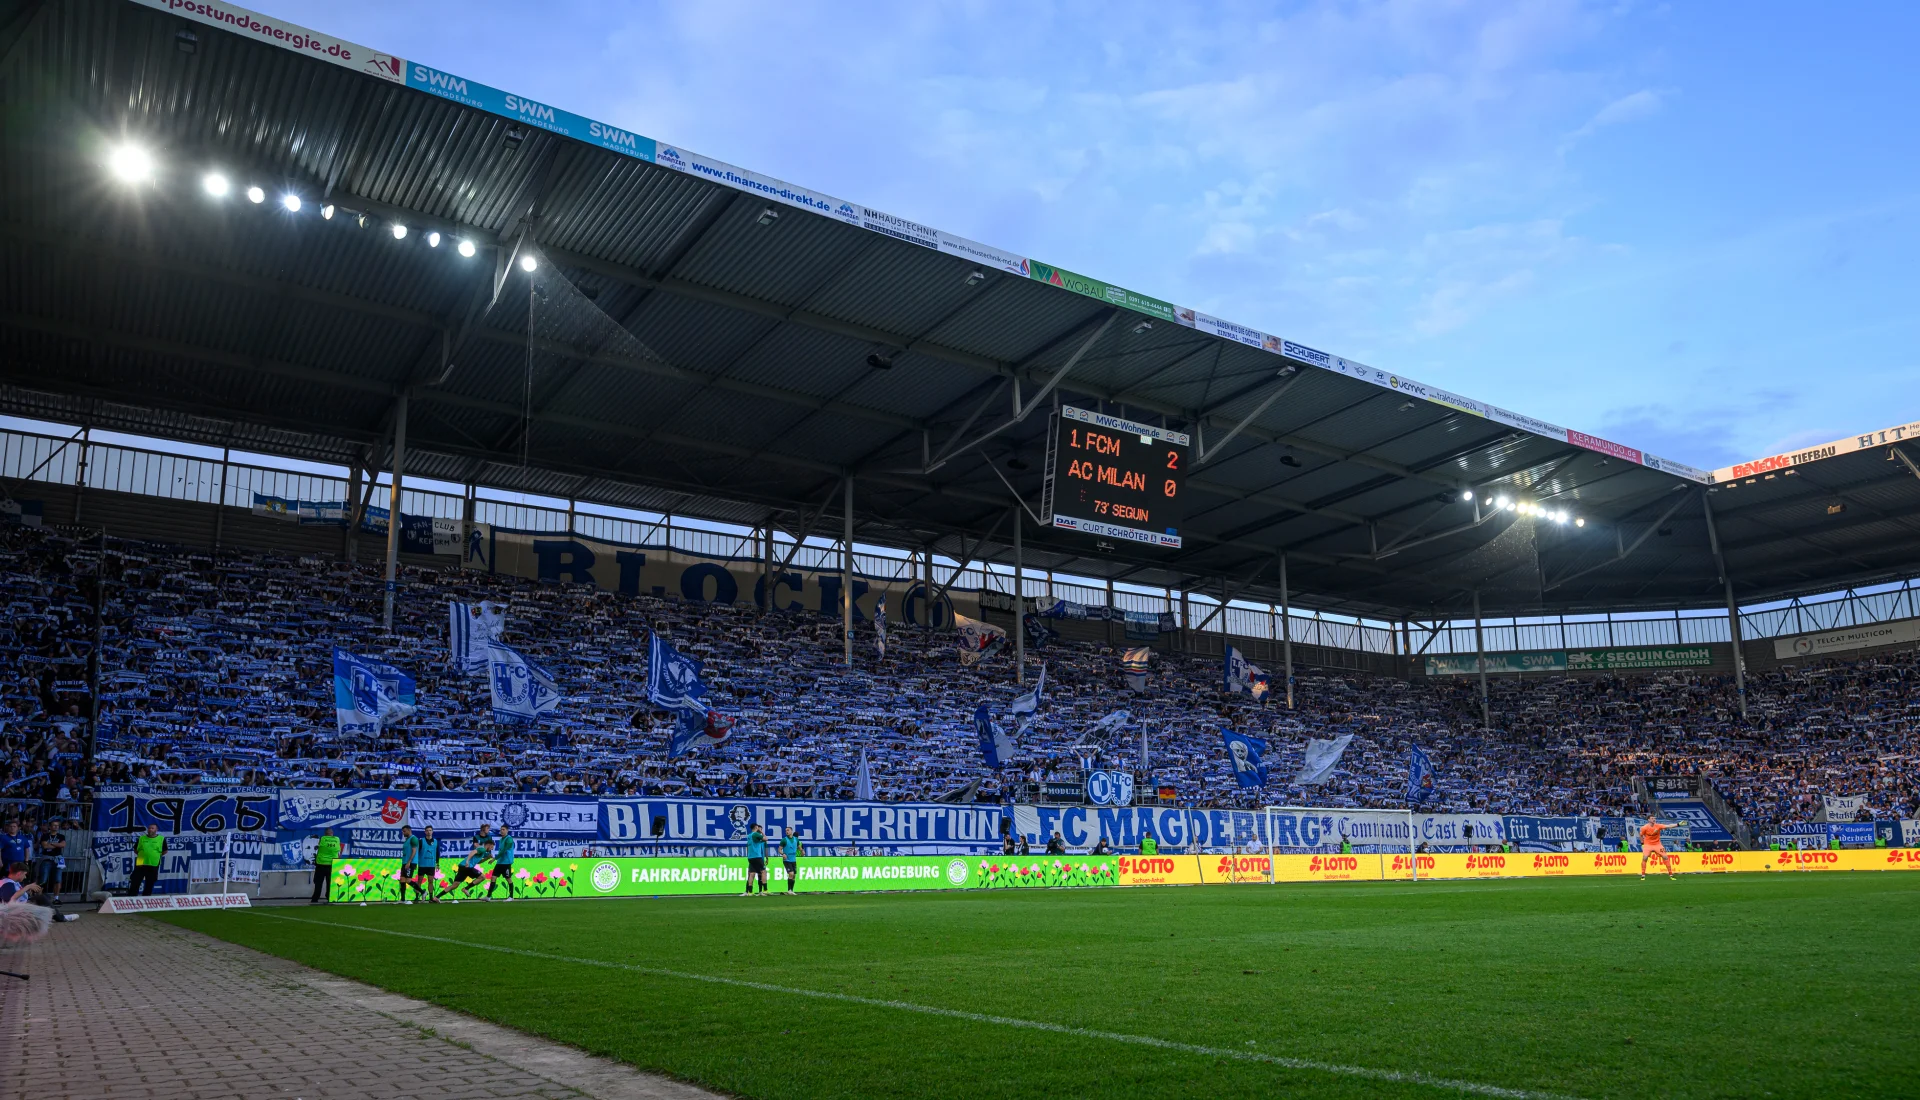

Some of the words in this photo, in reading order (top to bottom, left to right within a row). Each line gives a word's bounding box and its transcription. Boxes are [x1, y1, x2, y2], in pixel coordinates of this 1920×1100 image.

[162, 0, 352, 61] postundenergie.de
[414, 66, 468, 96] SWM
[429, 86, 483, 108] MAGDEBURG
[505, 95, 555, 123] SWM
[519, 115, 570, 135] MAGDEBURG
[589, 122, 637, 149] SWM
[602, 141, 650, 160] MAGDEBURG
[656, 153, 686, 167] FINANZEN
[691, 161, 830, 211] www.finanzen-direkt.de
[834, 207, 859, 220] FINANZEN
[1064, 277, 1104, 299] WOBAU
[1283, 341, 1330, 364] SCHUBERT
[1096, 415, 1160, 438] MWG-Wohnen.de
[1070, 429, 1081, 449] 1.
[1086, 432, 1121, 457] FCM
[1166, 451, 1179, 470] 2
[1572, 432, 1637, 458] KERAMUNDO.de
[1791, 446, 1836, 465] TIEFBAU
[1068, 459, 1093, 481] AC
[1097, 464, 1146, 492] MILAN
[1164, 479, 1176, 498] 0
[1094, 500, 1109, 515] 73'
[1112, 503, 1149, 522] SEGUIN
[1056, 517, 1077, 526] DAF
[1082, 522, 1105, 534] CURT
[1107, 526, 1149, 542] SCHRÖTER
[1160, 536, 1180, 545] DAF
[532, 540, 872, 621] BLOCK
[1816, 635, 1845, 645] TELCAT
[1847, 628, 1893, 640] MULTICOM
[1522, 655, 1555, 666] SWM
[1606, 651, 1663, 661] SEGUIN
[1664, 648, 1710, 660] GmbH
[129, 785, 144, 793] IST
[236, 786, 278, 794] VERLOREN
[308, 793, 383, 811] BÖRDE
[108, 794, 271, 835] 1965
[409, 809, 498, 822] FREITAG
[530, 811, 572, 822] DER
[578, 812, 597, 822] 13.
[608, 804, 726, 841] BLUE
[755, 806, 1001, 841] GENERATION
[1098, 806, 1321, 847] MAGDEBURG
[1337, 816, 1418, 841] Commando
[1422, 817, 1457, 840] East
[1508, 817, 1530, 840] für
[1537, 822, 1578, 840] immer
[1660, 829, 1690, 837] AGDEBURG
[1771, 837, 1815, 846] BREEN
[122, 855, 192, 875] BLIN
[1132, 858, 1174, 873] LOTTO
[1233, 857, 1271, 872] LOTTO
[1323, 857, 1358, 871] LOTTO
[1405, 856, 1435, 869] LOTTO
[1477, 856, 1506, 869] LOTTO
[1543, 855, 1569, 867] LOTTO
[1604, 854, 1627, 867] LOTTO
[1709, 853, 1734, 865] LOTTO
[1795, 852, 1838, 864] LOTTO
[631, 865, 771, 883] FAHRRADFRÜHLIG
[799, 866, 858, 880] FAHRRAD
[862, 865, 940, 879] MAGDEBURG
[144, 897, 175, 909] HOUSE
[175, 896, 213, 908] BRALO
[214, 895, 249, 907] HOUSE
